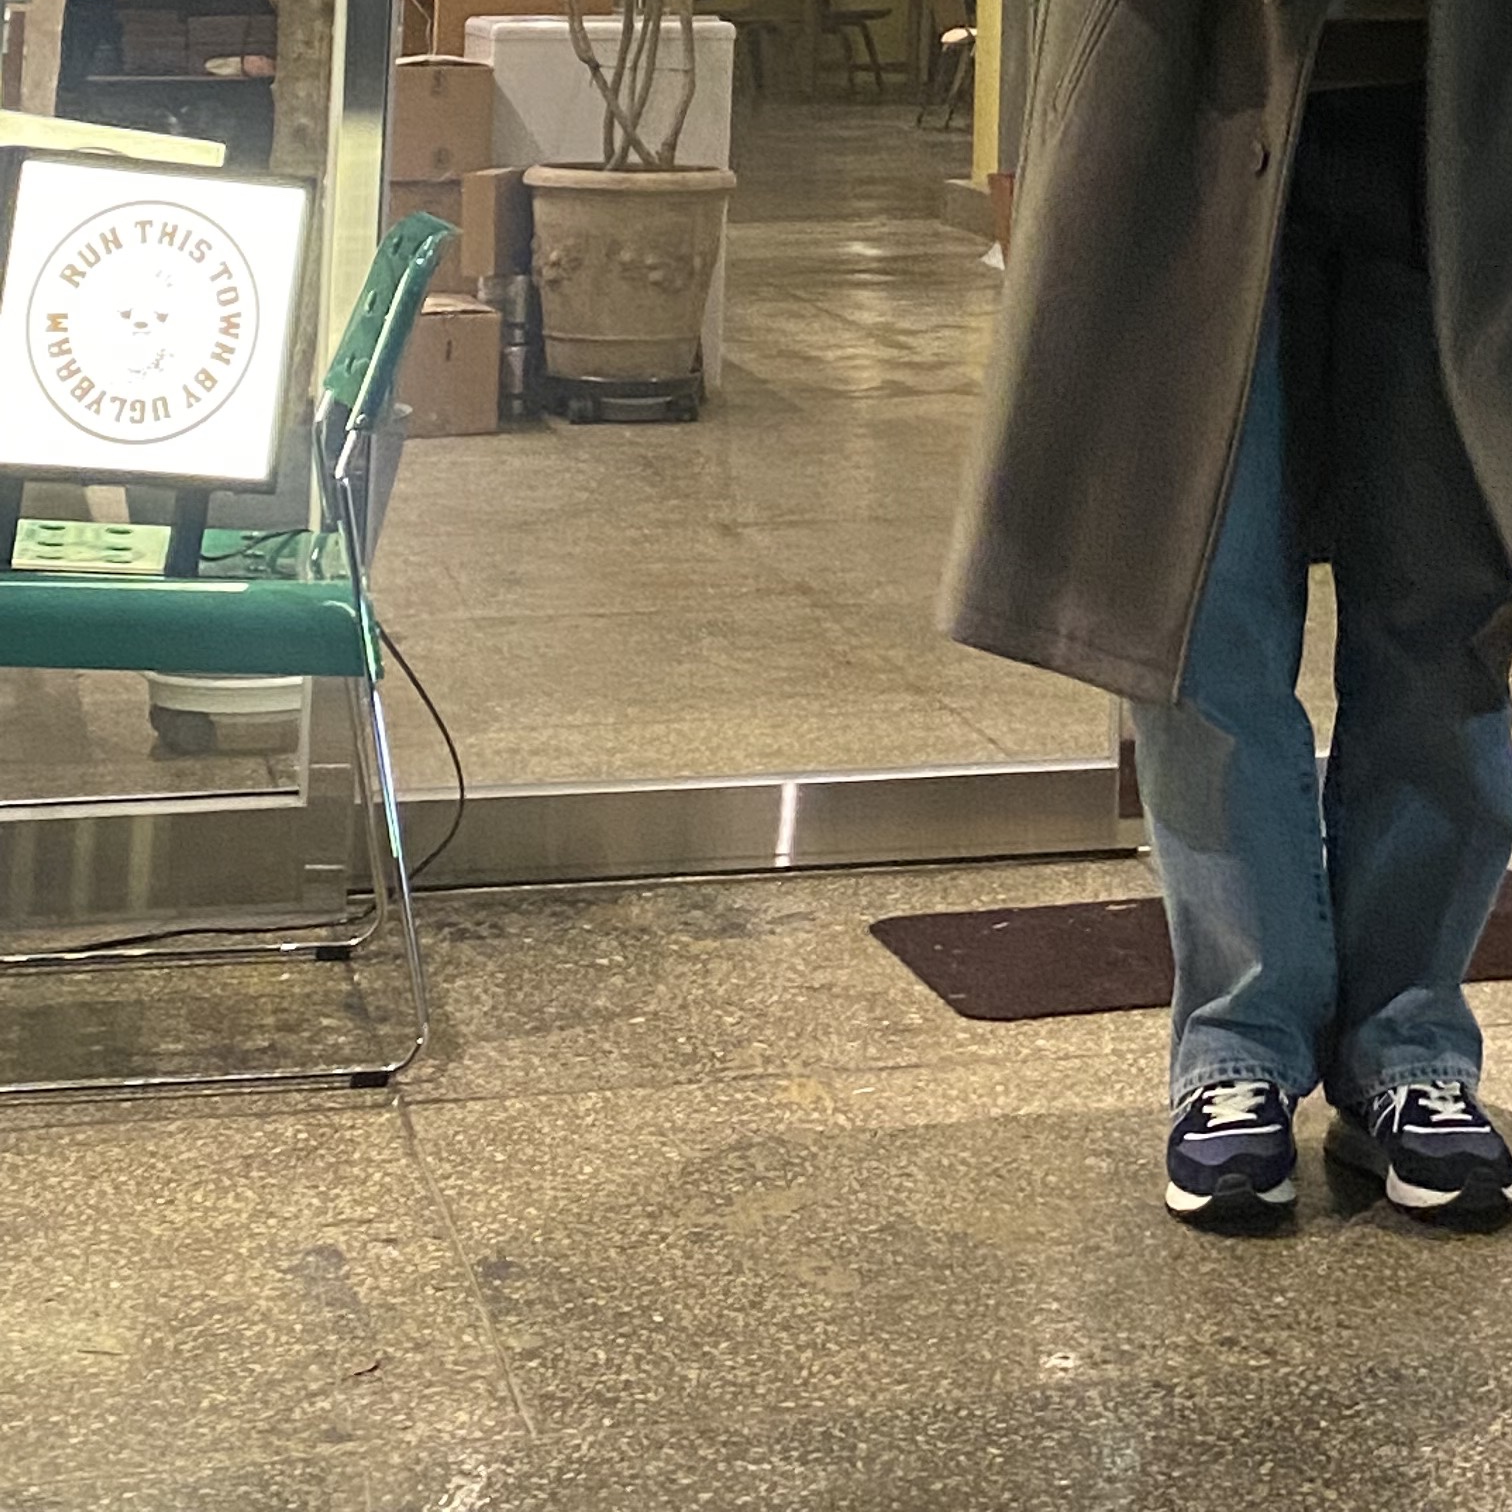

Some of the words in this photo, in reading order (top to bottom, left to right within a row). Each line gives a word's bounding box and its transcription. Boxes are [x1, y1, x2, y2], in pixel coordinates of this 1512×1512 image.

[58, 225, 124, 290] RUN
[133, 219, 214, 264] THIS
[208, 260, 243, 367] TOWN
[181, 366, 219, 410] BY
